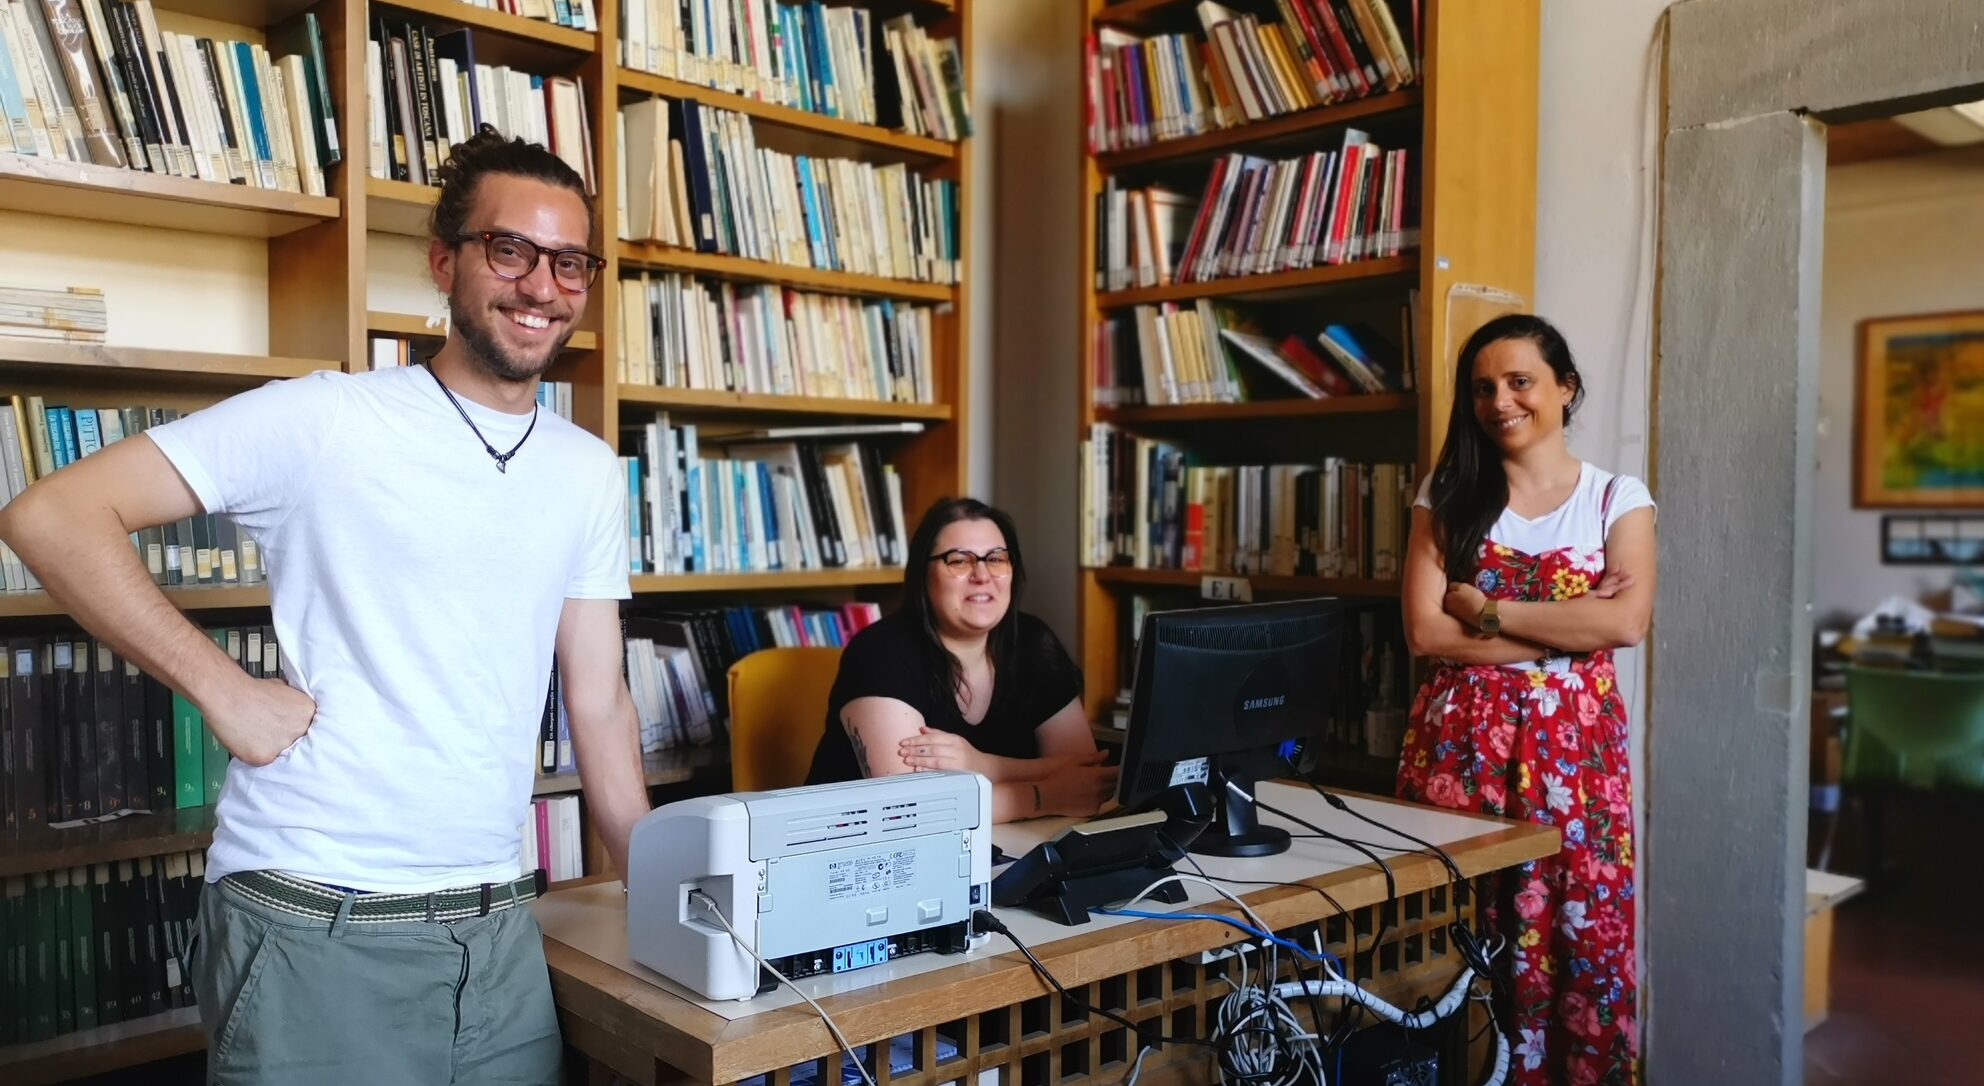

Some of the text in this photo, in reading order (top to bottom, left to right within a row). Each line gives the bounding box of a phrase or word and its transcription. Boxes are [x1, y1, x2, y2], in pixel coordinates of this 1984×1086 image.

[427, 38, 437, 82] Pontormo
[415, 60, 426, 92] ARTISTI
[421, 102, 432, 137] TOSCANA
[1243, 695, 1285, 711] SAMSUNG
